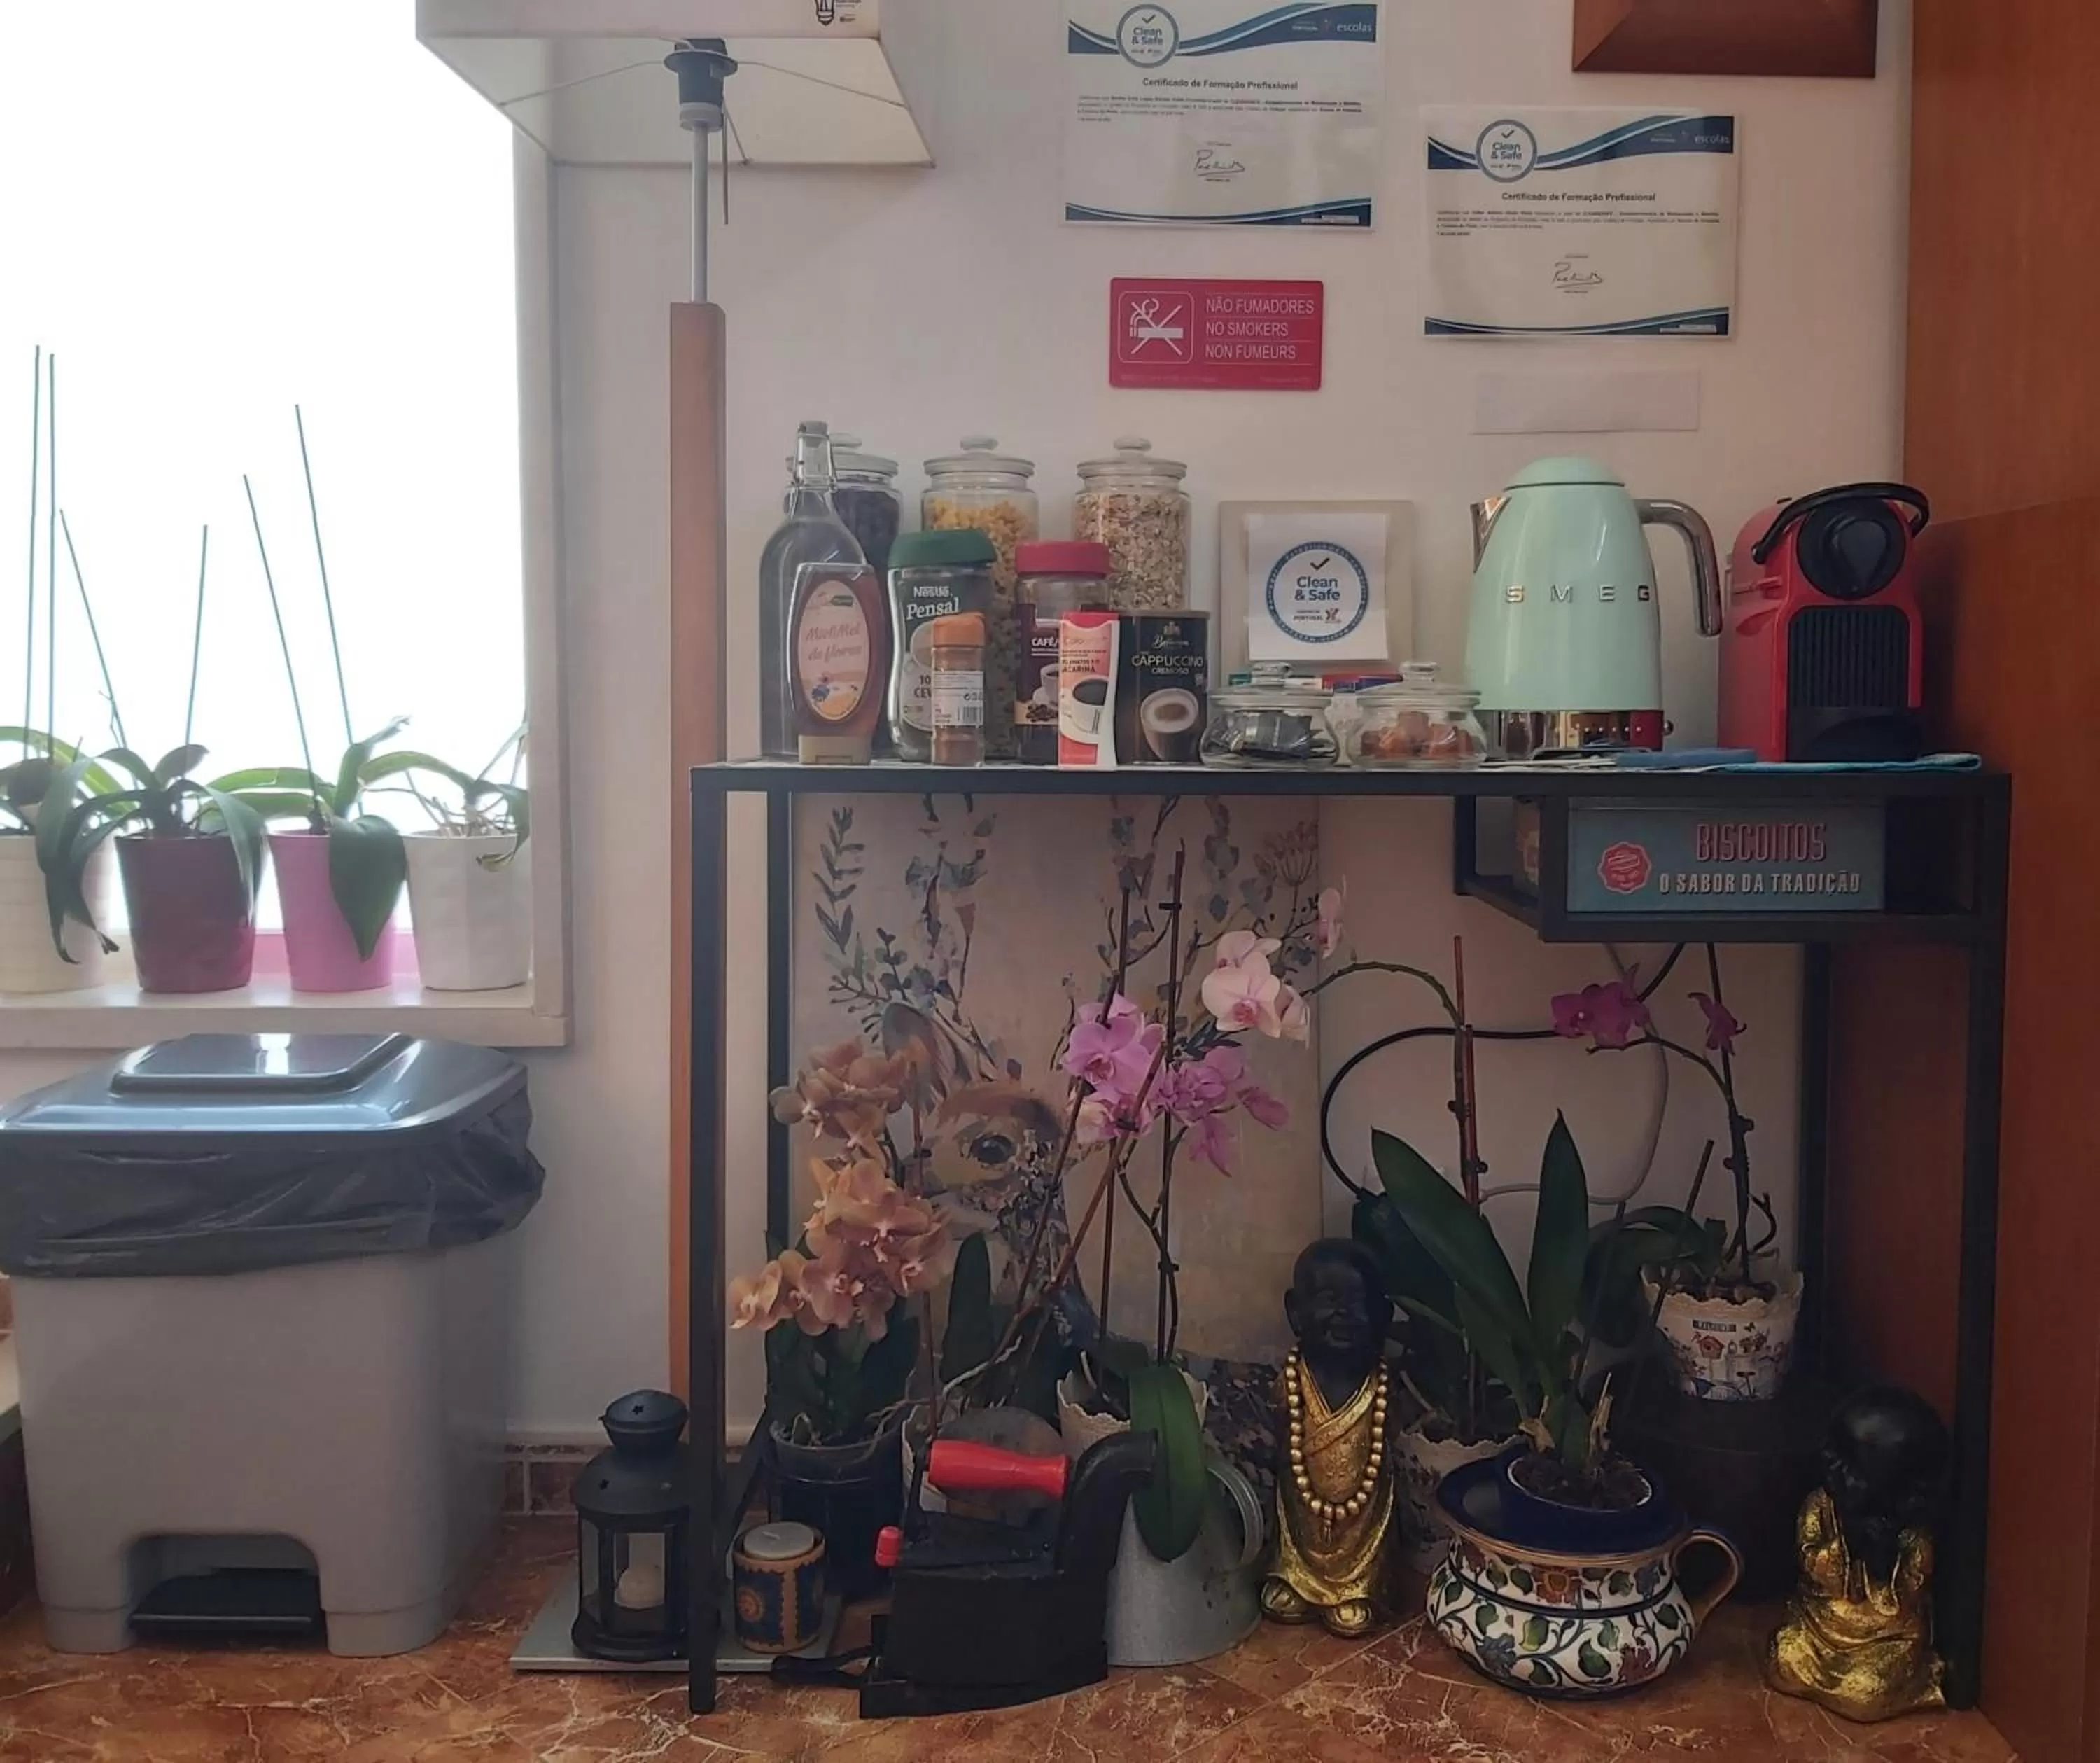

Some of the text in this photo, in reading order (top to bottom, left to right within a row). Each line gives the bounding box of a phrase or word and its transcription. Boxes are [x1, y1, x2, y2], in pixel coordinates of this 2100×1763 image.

[1133, 27, 1163, 36] Clean
[1336, 22, 1372, 32] escolas
[1142, 36, 1163, 45] Safe
[1142, 78, 1298, 90] Certificado de Formação Profissional
[1492, 141, 1521, 151] Clean
[1500, 151, 1522, 160] Safe
[1502, 192, 1656, 203] Certificado de Formação Profissional
[1205, 297, 1315, 314] NÃO FUMADORES
[1205, 321, 1289, 337] NO SMOKERS
[1205, 344, 1296, 359] NON FUMEURS
[1296, 576, 1338, 588] Clean
[1294, 588, 1340, 601] & Safe
[1505, 585, 1651, 602] SMEG
[906, 597, 961, 620] Pensal
[1131, 655, 1204, 667] CAPPUCCINO
[1695, 823, 1828, 862] BISCOITOS
[1658, 870, 1861, 897] O SABOR DA TRADIÇÃO
